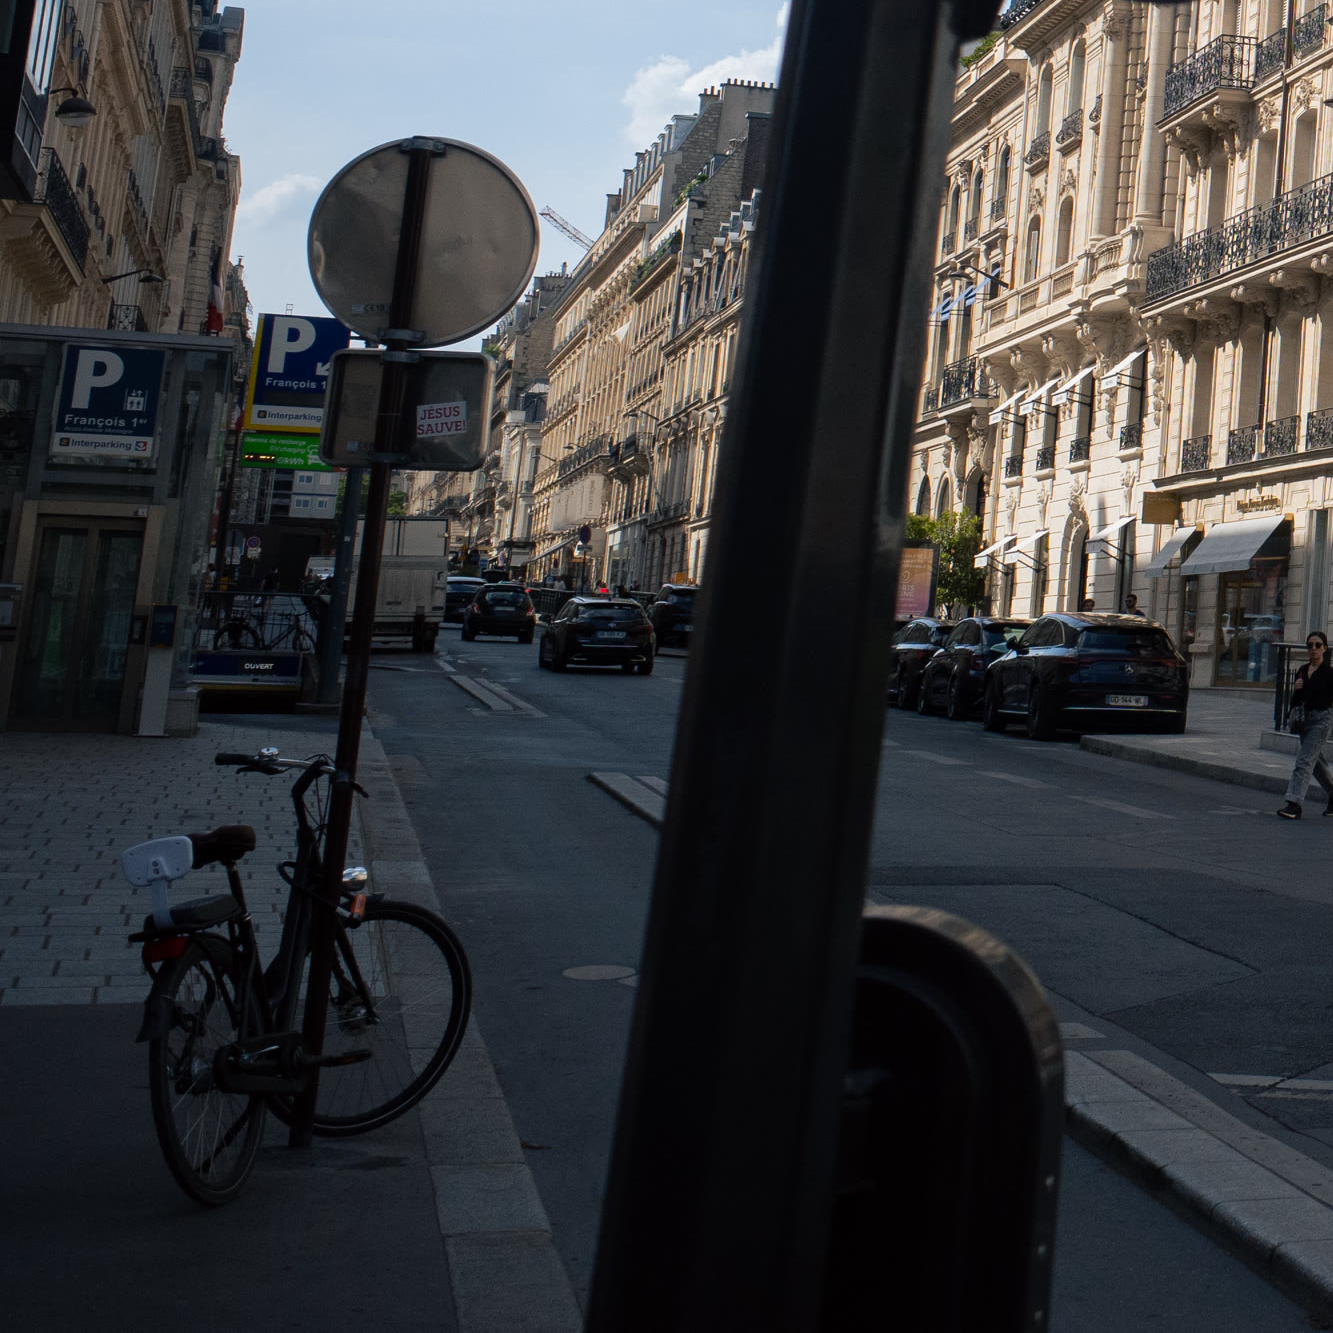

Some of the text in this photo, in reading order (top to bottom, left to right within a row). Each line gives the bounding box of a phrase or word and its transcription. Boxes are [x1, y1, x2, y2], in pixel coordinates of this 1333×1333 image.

[267, 316, 317, 374] P
[71, 349, 124, 410] P
[265, 377, 317, 390] François
[64, 414, 126, 429] François
[268, 412, 322, 422] Interparking
[420, 406, 460, 423] JÉSUS
[417, 420, 466, 435] SAUVE!
[71, 438, 131, 451] Interparking
[244, 663, 275, 671] OUVERT
